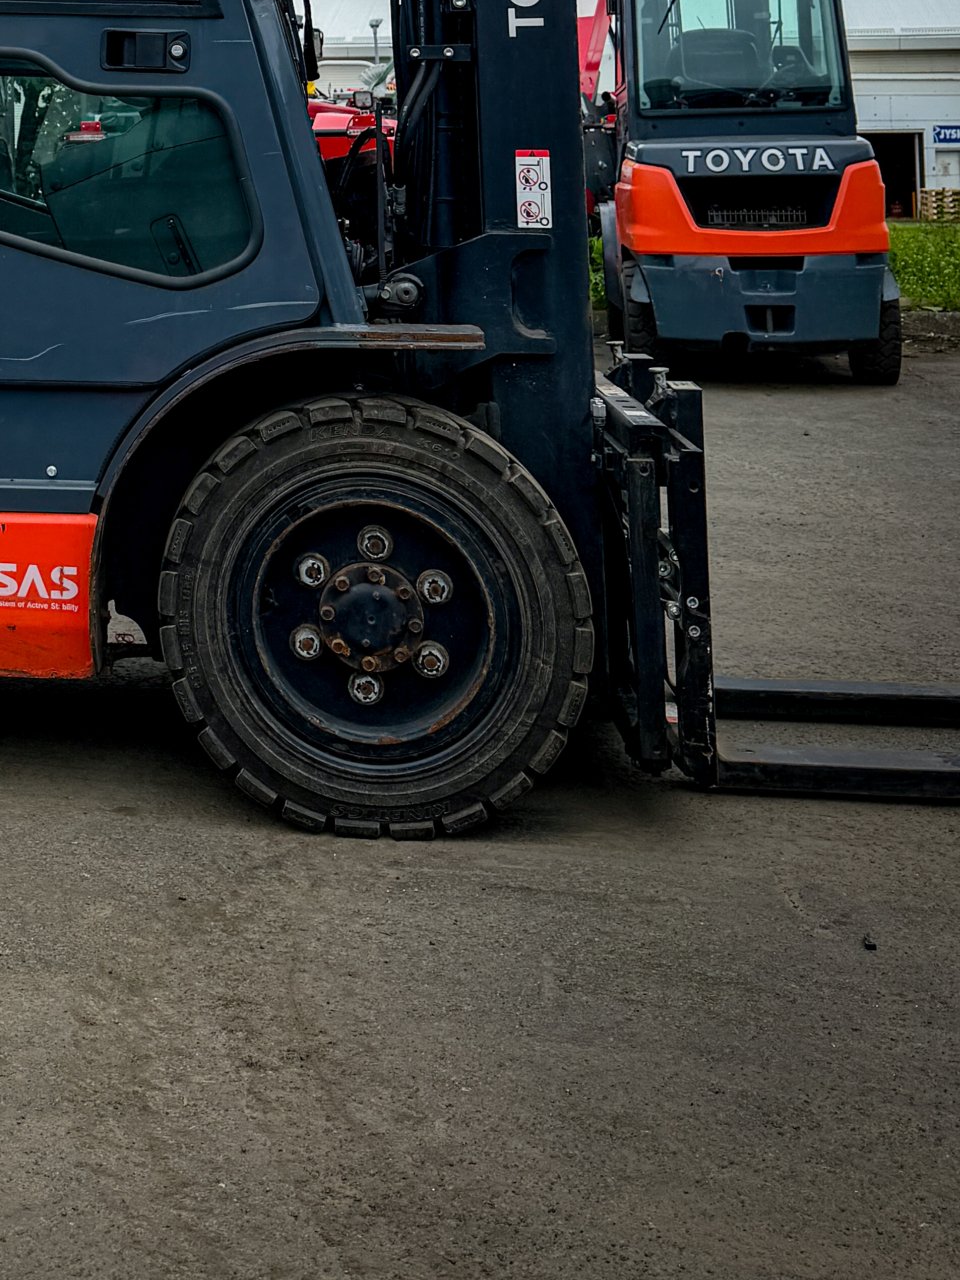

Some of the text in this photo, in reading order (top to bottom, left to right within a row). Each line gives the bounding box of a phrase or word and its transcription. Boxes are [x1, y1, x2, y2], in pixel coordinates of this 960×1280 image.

[939, 128, 960, 140] JYS
[681, 147, 835, 172] TOYOTA
[27, 601, 49, 609] Active
[50, 602, 79, 612] Stbility
